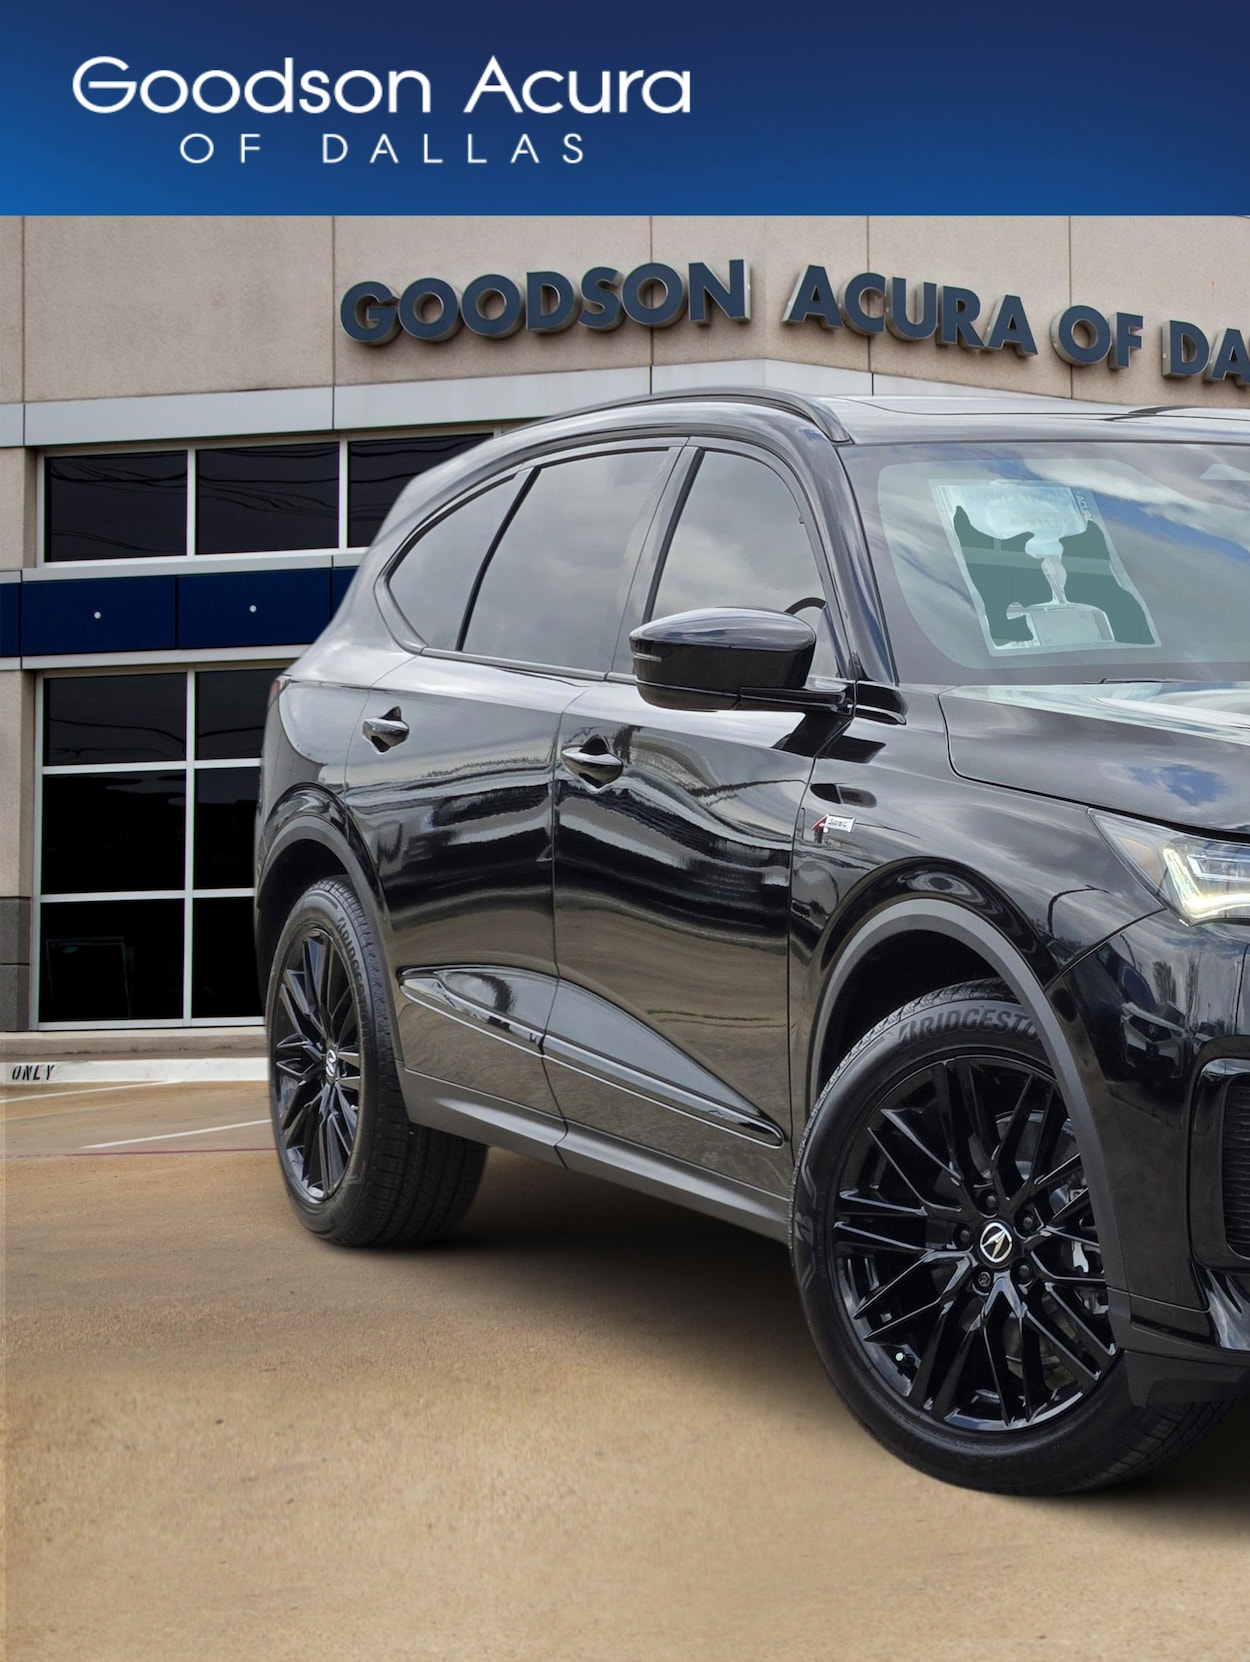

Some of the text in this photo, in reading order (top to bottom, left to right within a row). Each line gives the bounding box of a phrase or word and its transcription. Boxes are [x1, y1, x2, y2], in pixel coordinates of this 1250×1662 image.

[340, 258, 751, 346] GOODSON
[781, 263, 1038, 358] ACURA
[1050, 304, 1144, 369] OF
[12, 1064, 55, 1081] ONLY
